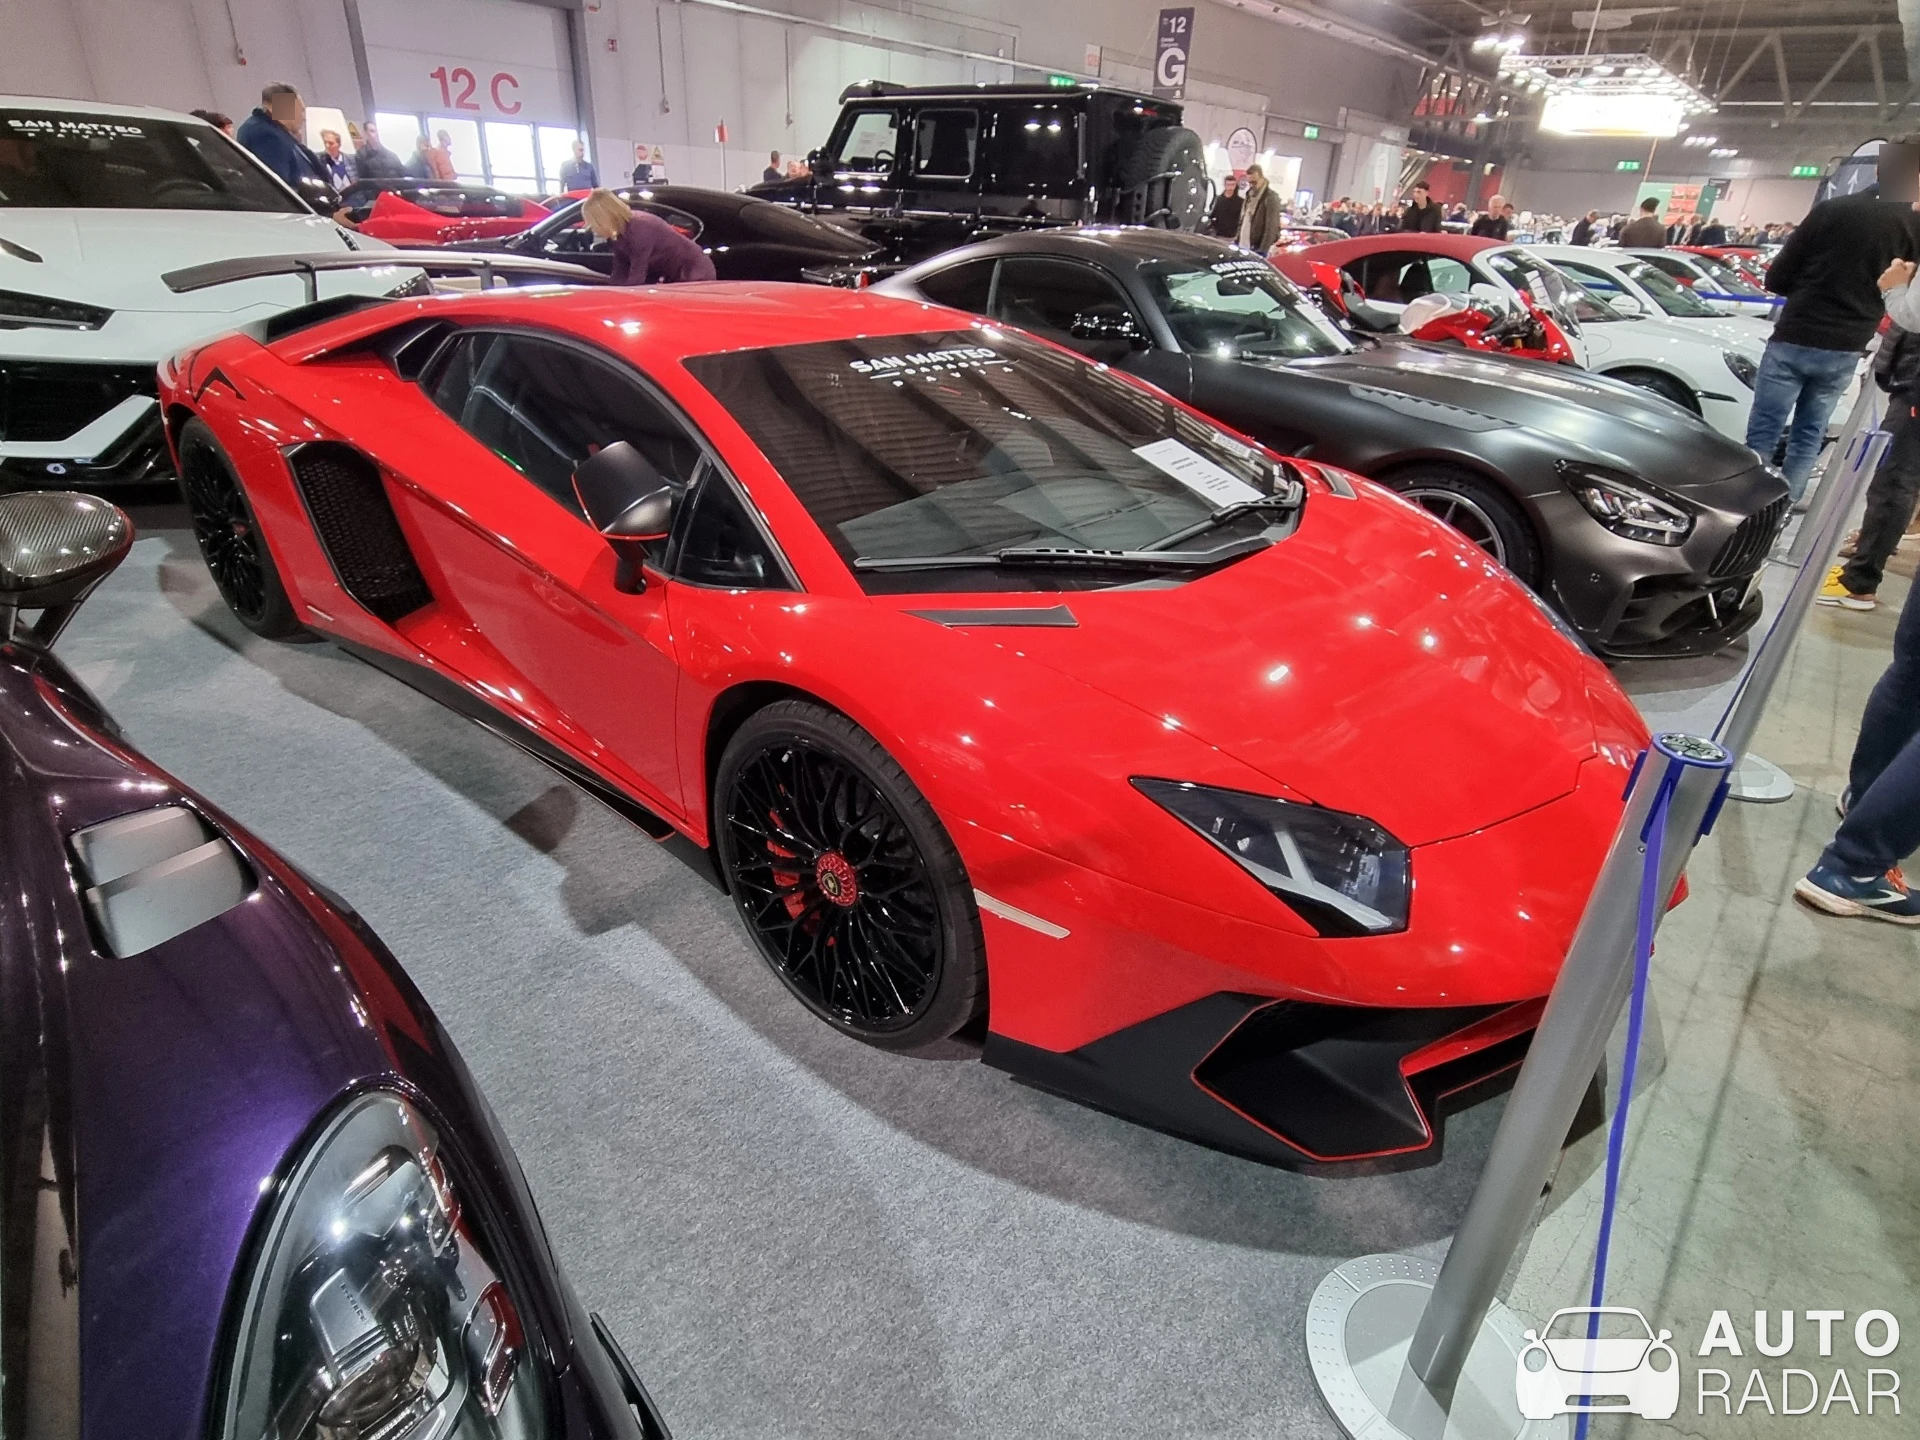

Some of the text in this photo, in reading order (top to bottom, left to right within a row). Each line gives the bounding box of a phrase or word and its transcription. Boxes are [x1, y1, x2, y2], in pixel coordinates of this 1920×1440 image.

[1169, 16, 1187, 33] 12
[1157, 47, 1186, 87] G
[429, 66, 522, 115] 12 C
[7, 120, 53, 128] SAN
[58, 121, 142, 134] MATTEO
[849, 348, 997, 373] SAN MATTEO
